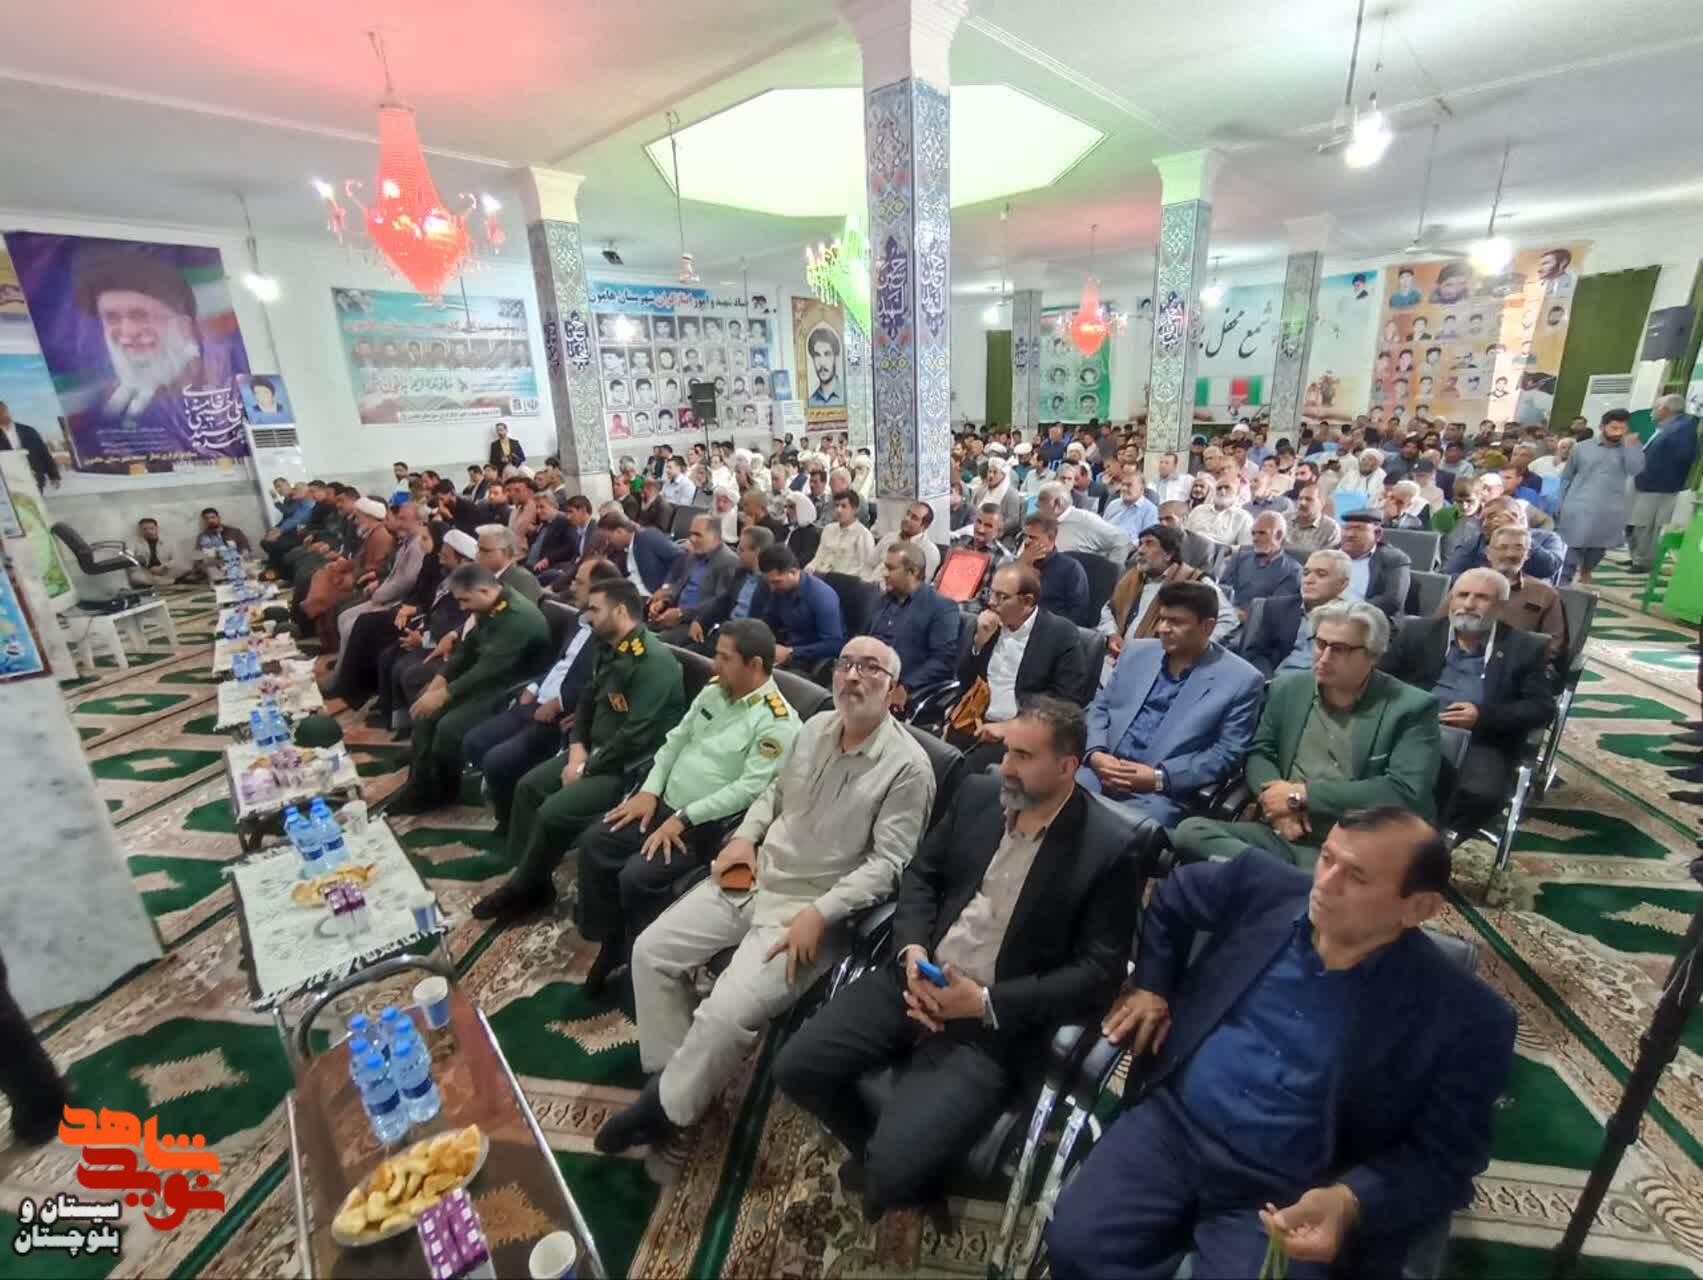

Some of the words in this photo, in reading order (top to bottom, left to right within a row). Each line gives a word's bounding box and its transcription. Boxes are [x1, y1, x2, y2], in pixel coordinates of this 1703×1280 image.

[588, 288, 616, 304] هامون
[617, 288, 655, 305] شهرستان
[1205, 306, 1245, 358] محفل
[1238, 299, 1272, 358] شمع
